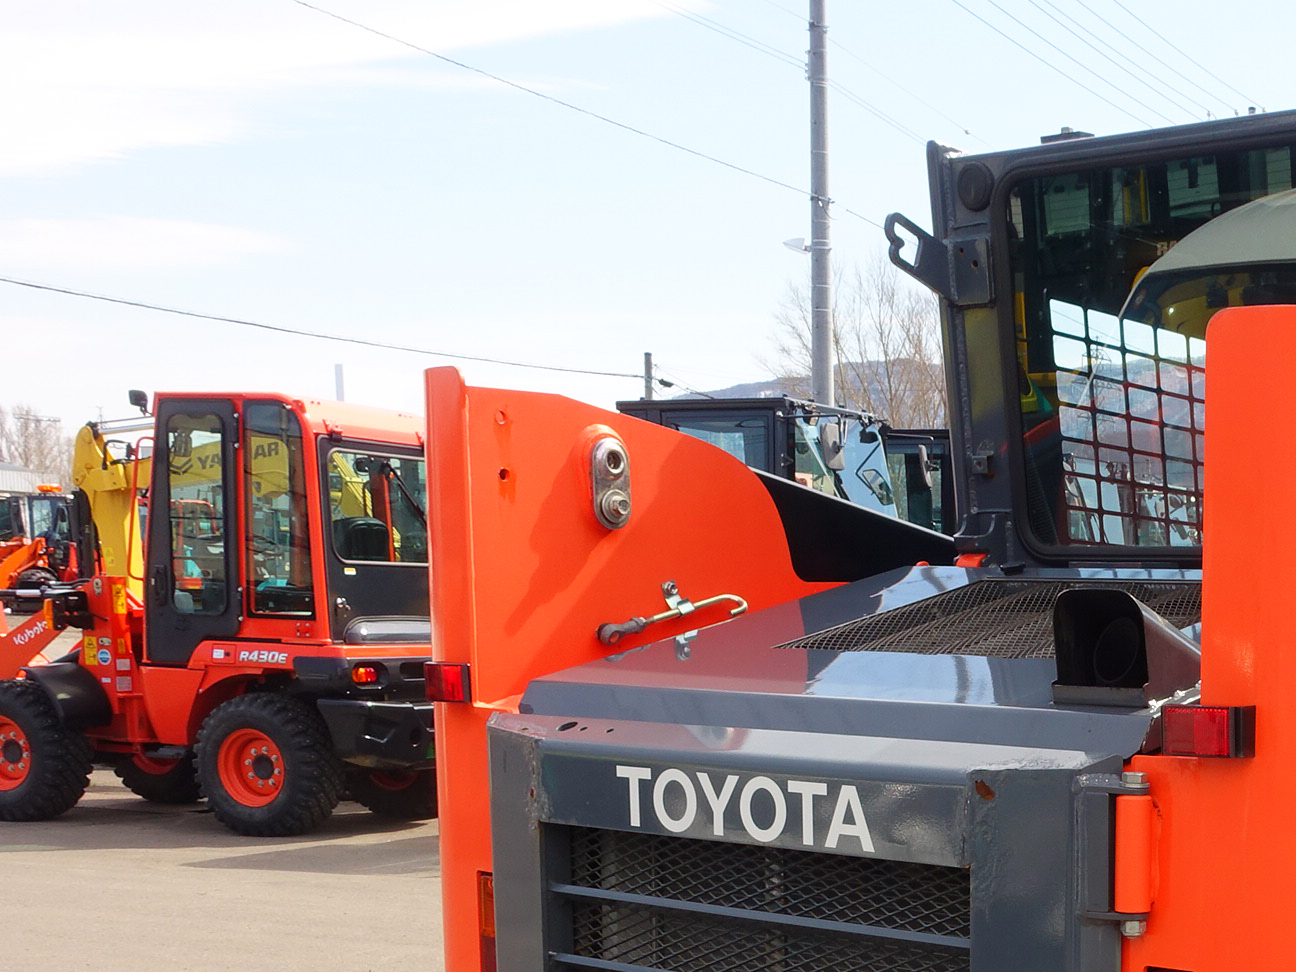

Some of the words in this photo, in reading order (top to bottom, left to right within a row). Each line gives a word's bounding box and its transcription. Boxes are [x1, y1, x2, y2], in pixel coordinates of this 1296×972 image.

[196, 440, 280, 470] YAAR
[239, 650, 288, 664] R430E
[615, 764, 876, 853] TOYOTA
